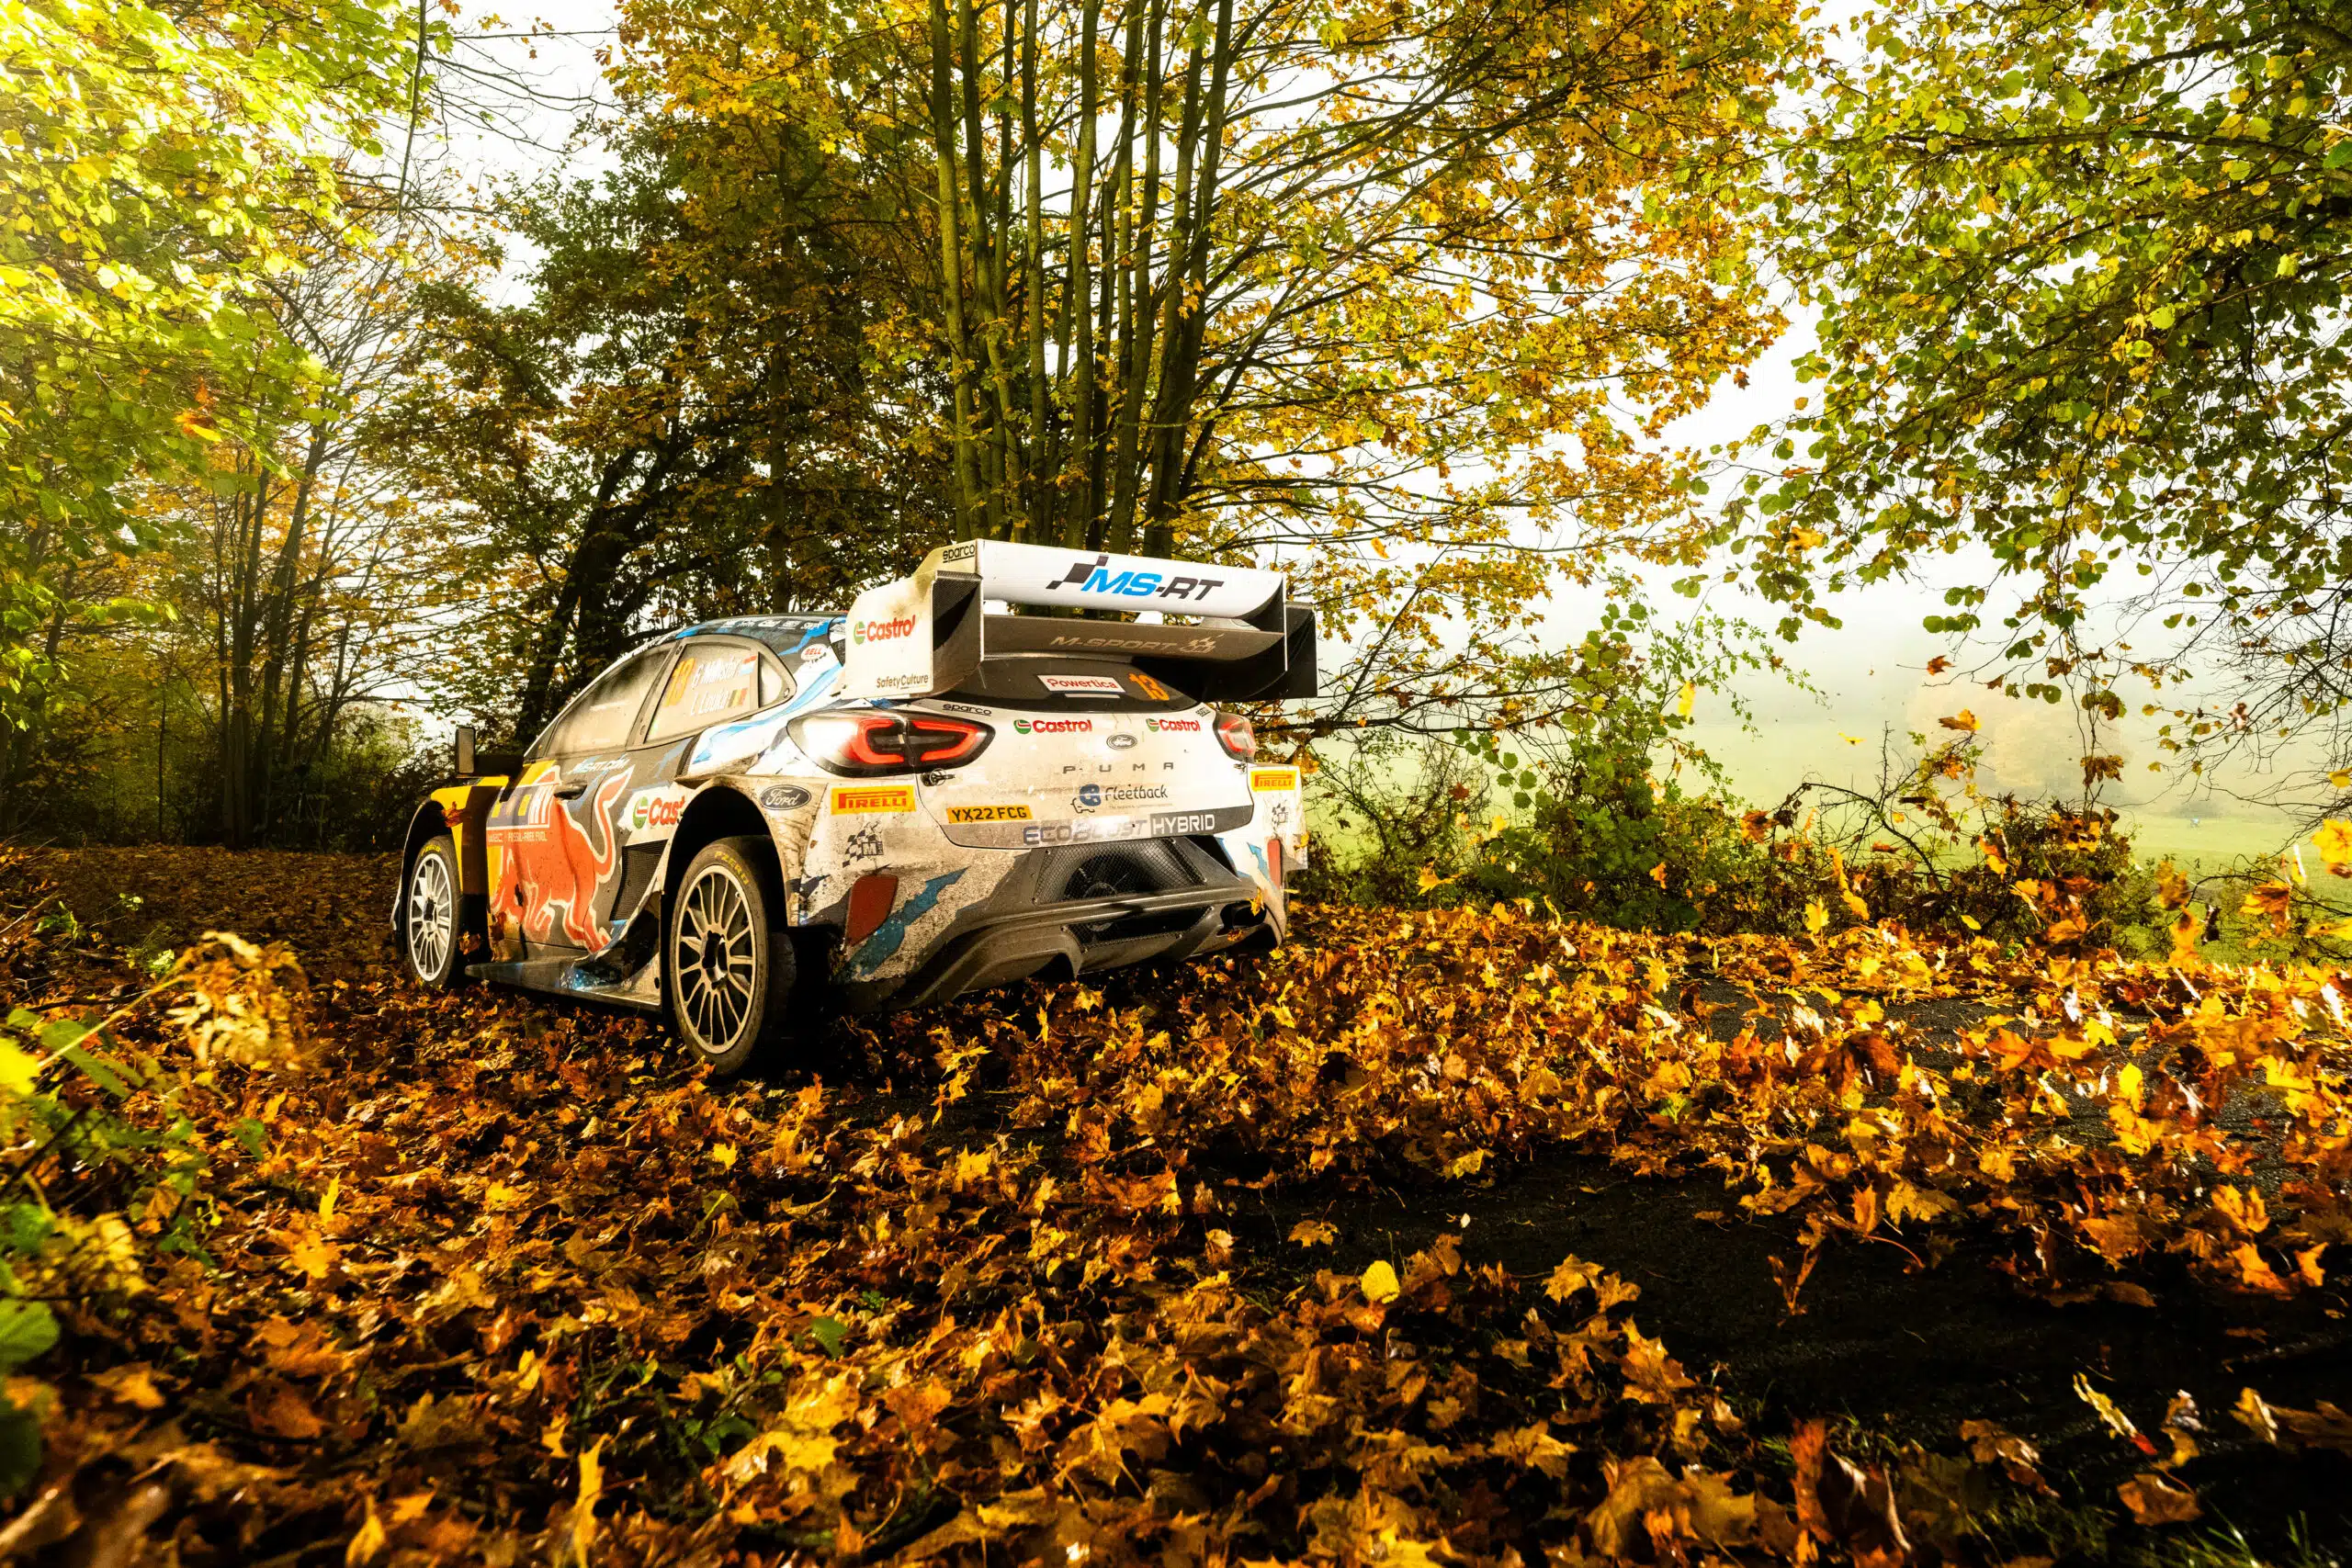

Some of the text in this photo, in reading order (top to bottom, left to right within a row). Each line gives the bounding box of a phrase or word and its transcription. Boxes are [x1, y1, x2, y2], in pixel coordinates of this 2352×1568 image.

[943, 544, 976, 562] sparco
[1080, 569, 1225, 601] MS-RT
[867, 615, 916, 642] Castrol
[1050, 636, 1178, 650] M-SPORT
[876, 674, 929, 689] SafetyCulture
[1046, 678, 1118, 689] Powertica
[943, 703, 992, 716] sparco
[1033, 718, 1092, 734] Castrol
[1159, 718, 1201, 732] Castrol
[1254, 773, 1293, 787] PIRELLI
[765, 787, 799, 806] Ford
[838, 790, 908, 809] PIRELLI
[1104, 784, 1169, 801] Fleetback
[951, 807, 1027, 822] YX22 FCG
[1023, 814, 1216, 845] ECOBST HYBRID
